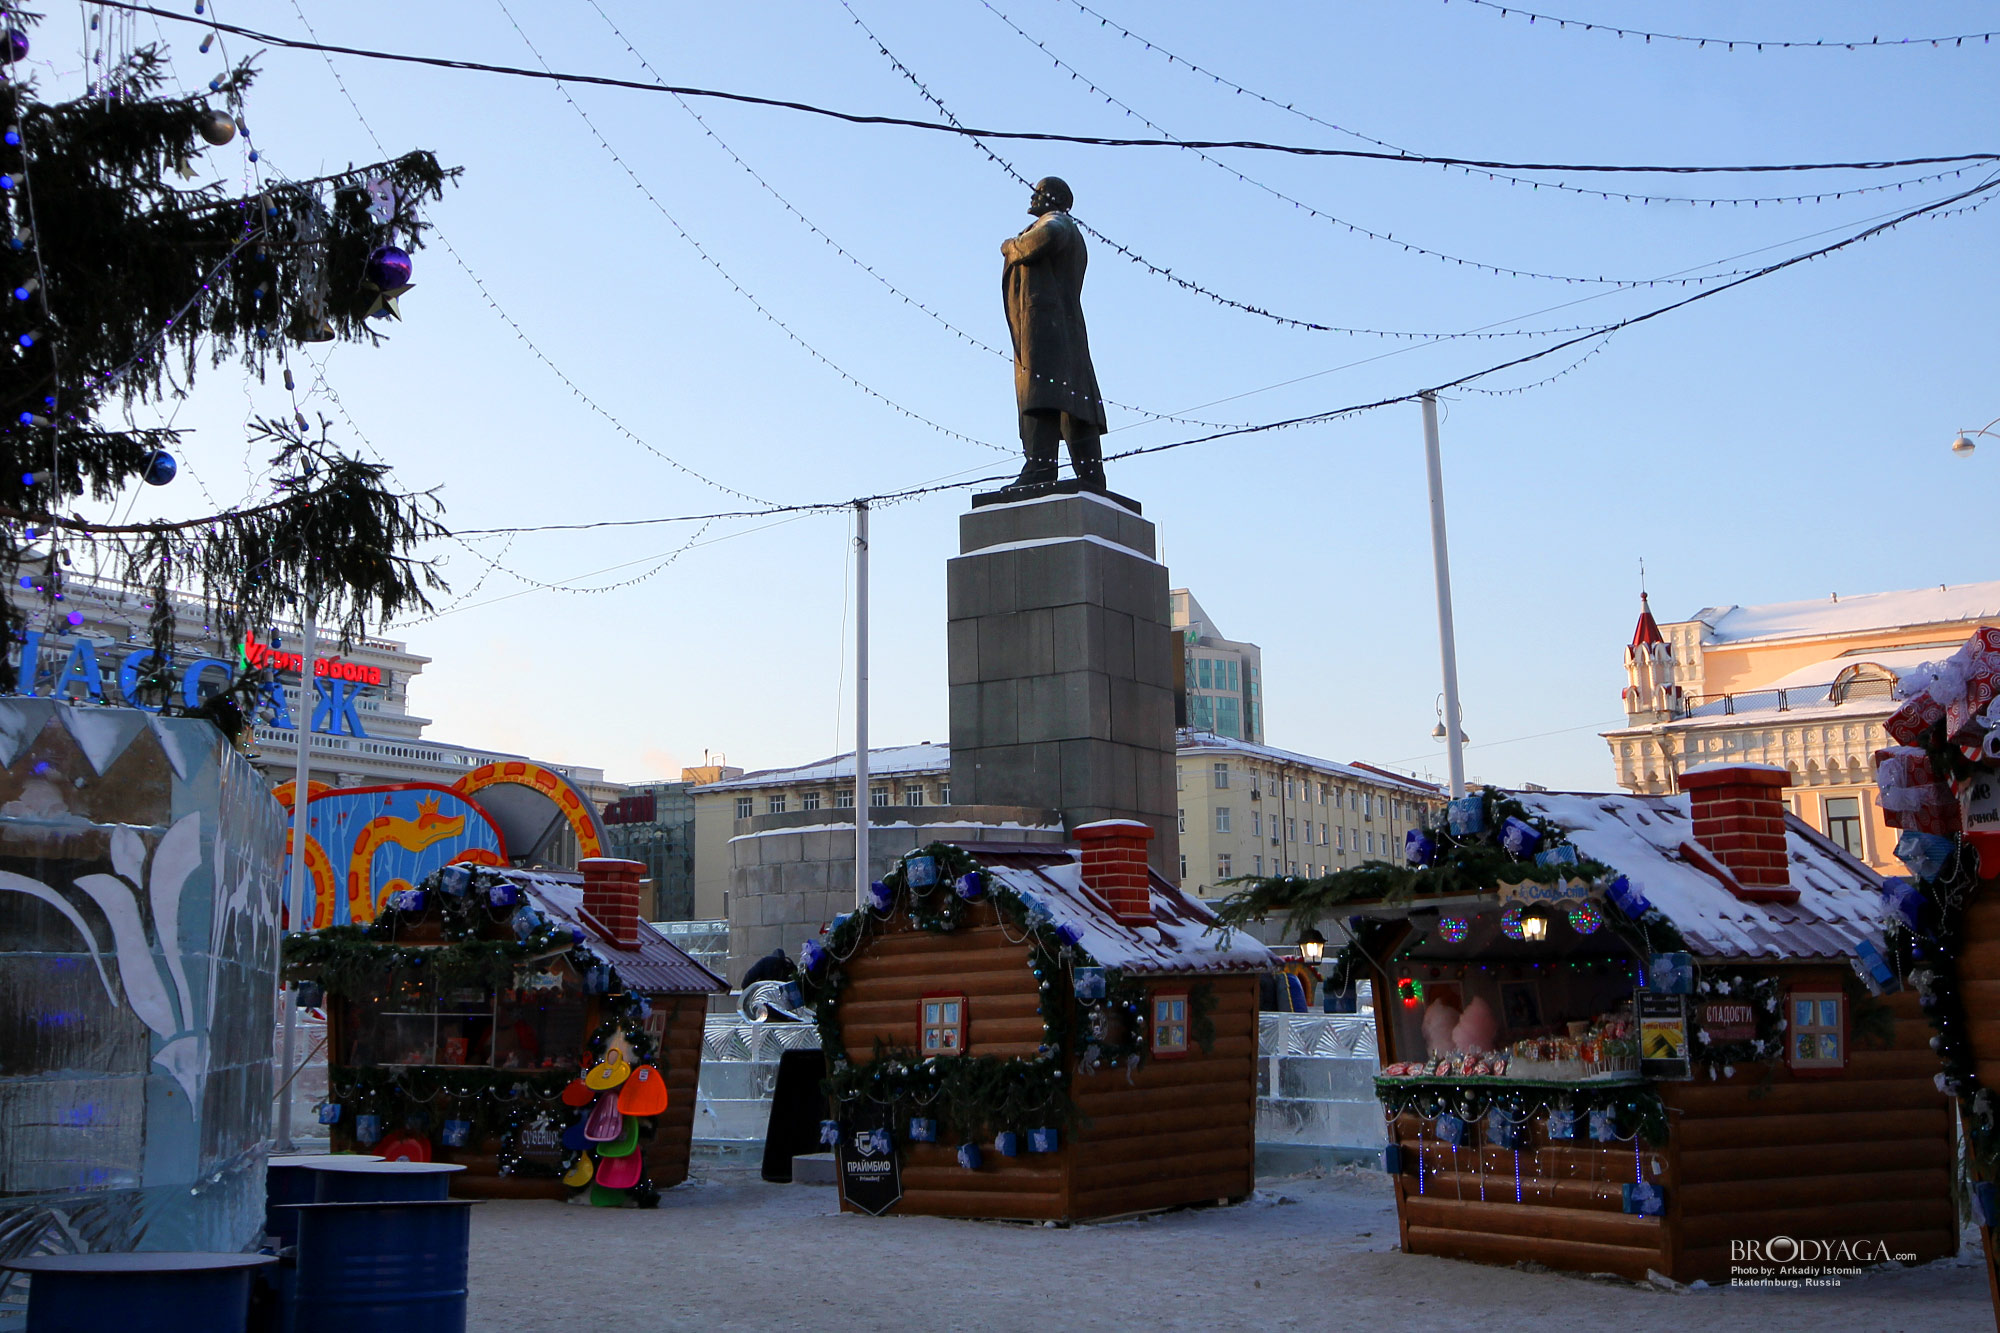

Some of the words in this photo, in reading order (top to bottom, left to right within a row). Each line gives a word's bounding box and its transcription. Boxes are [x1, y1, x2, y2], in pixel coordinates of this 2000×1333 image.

[264, 649, 381, 685] гипрбола
[1706, 1005, 1752, 1026] СЛАДОСТИ
[847, 1160, 891, 1172] ПРАЙМБИФ
